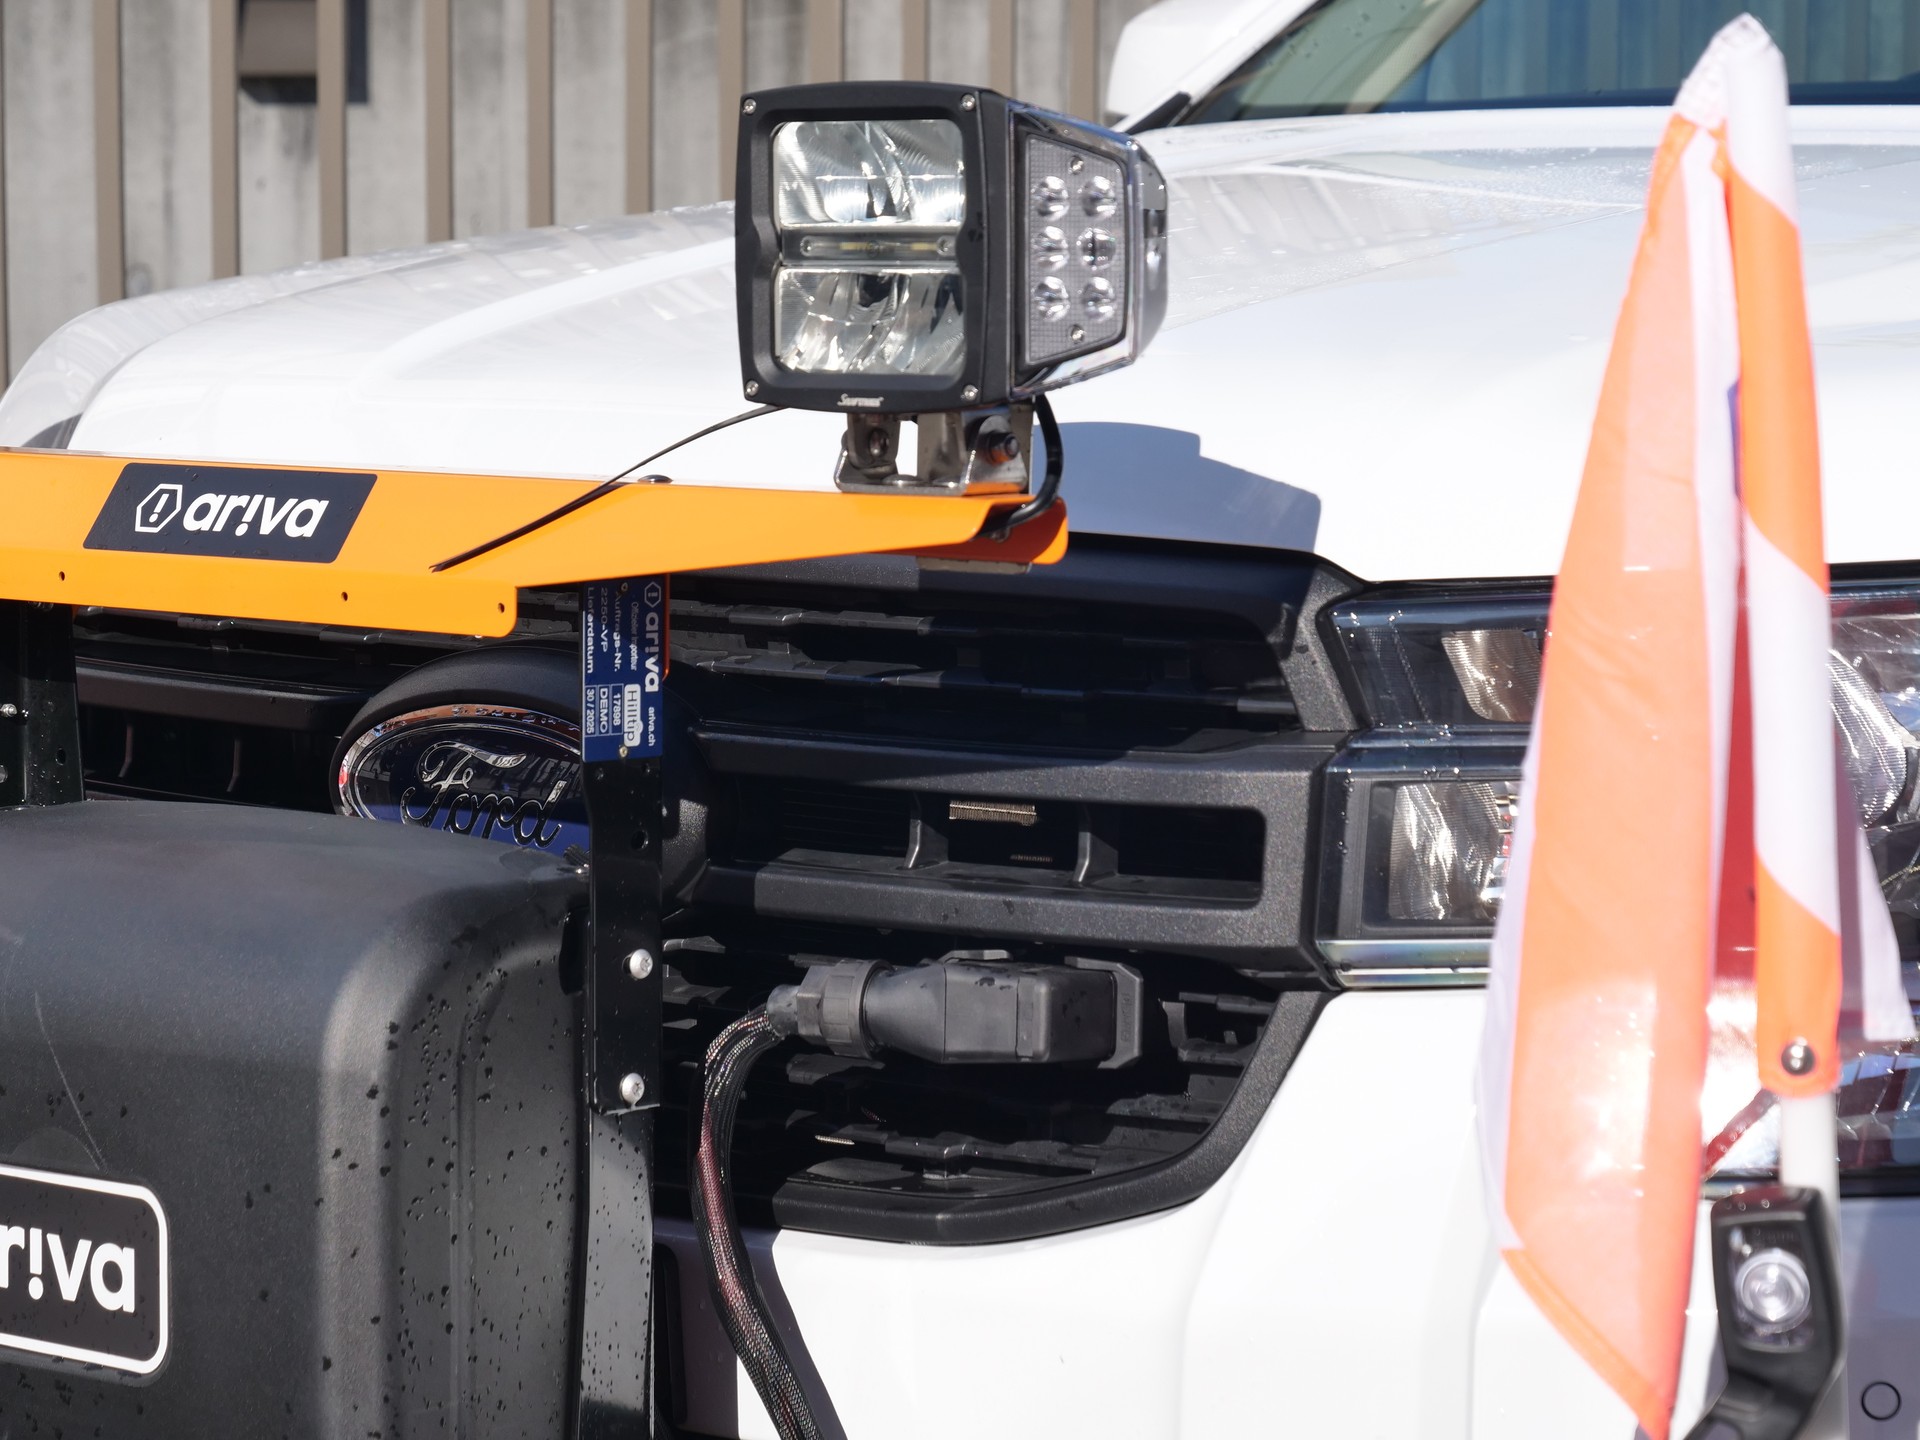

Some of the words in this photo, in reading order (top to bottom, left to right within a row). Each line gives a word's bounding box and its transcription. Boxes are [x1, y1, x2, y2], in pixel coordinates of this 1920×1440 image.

[587, 587, 595, 674] Lieferdatum
[613, 591, 621, 672] Auftrags-Nr.
[586, 689, 594, 702] 30
[600, 688, 608, 733] DEMO
[613, 693, 621, 726] 17898
[624, 690, 637, 741] Hilltip
[586, 709, 595, 734] 2025
[648, 706, 656, 747] ariva.ch
[400, 740, 567, 849] Ford
